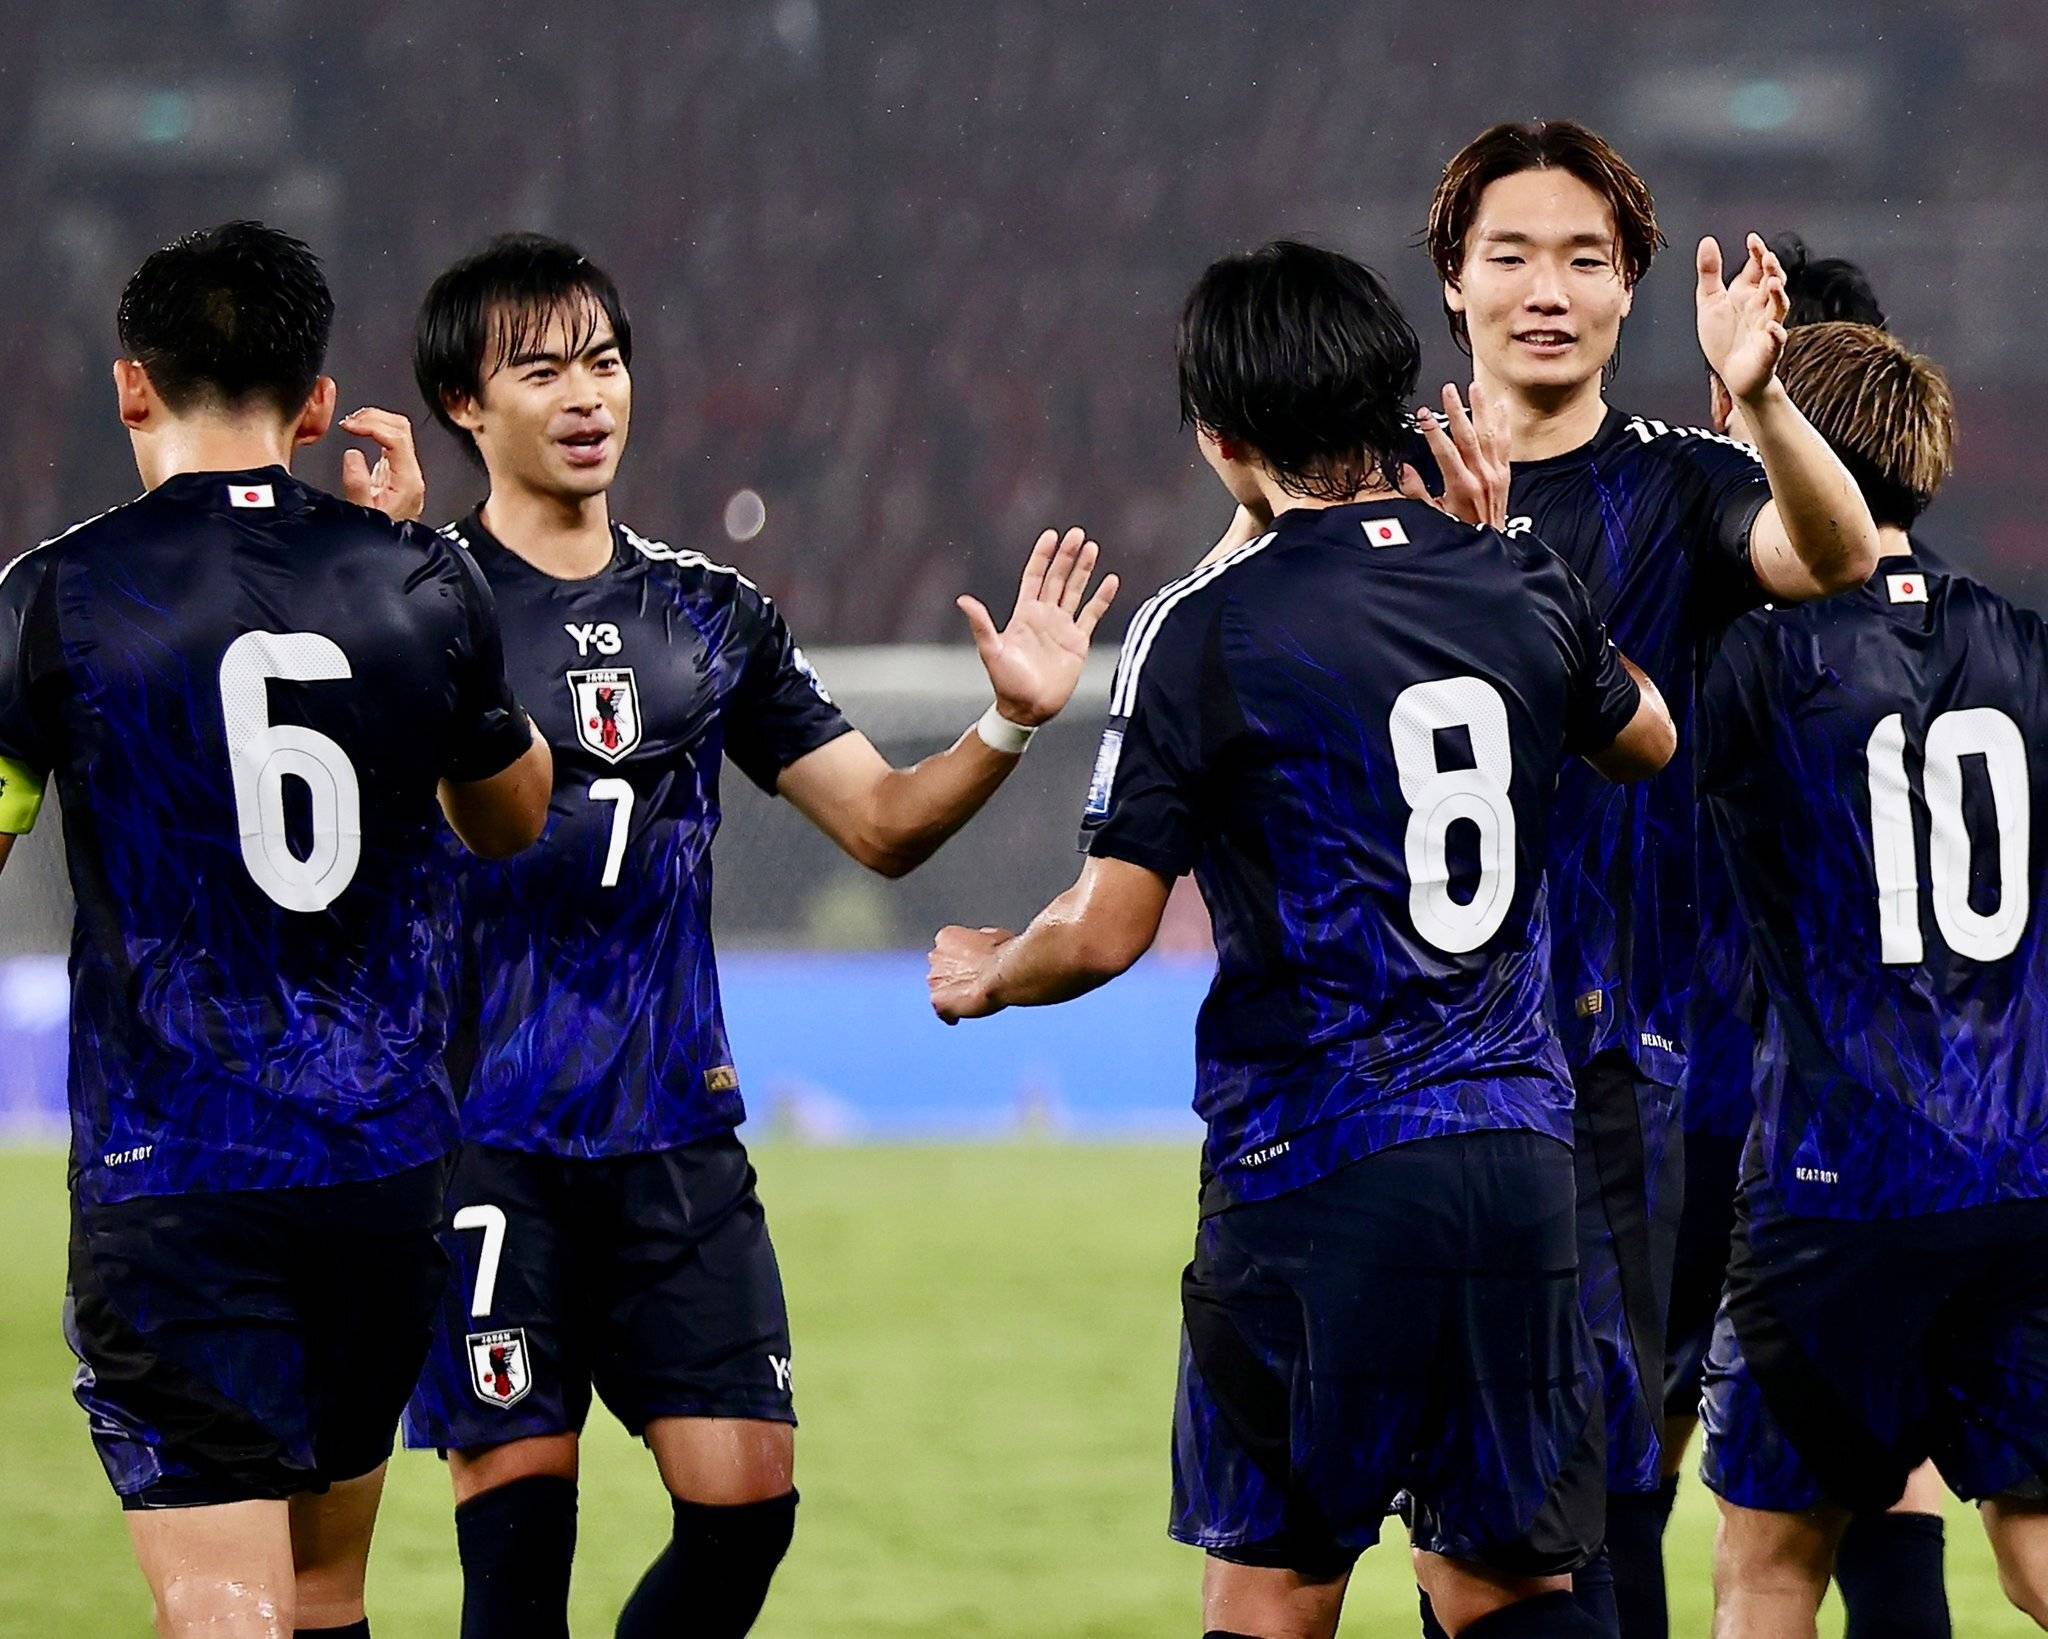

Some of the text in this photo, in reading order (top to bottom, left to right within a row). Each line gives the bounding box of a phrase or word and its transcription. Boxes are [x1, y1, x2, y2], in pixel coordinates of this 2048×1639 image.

[564, 622, 623, 656] Y-3
[585, 672, 618, 684] JAPAN
[219, 631, 361, 913] 6
[1388, 676, 1516, 954] 8
[588, 778, 635, 887] 7
[1866, 707, 2030, 964] 10
[453, 1204, 507, 1318] 7
[768, 1355, 793, 1391] Y-
